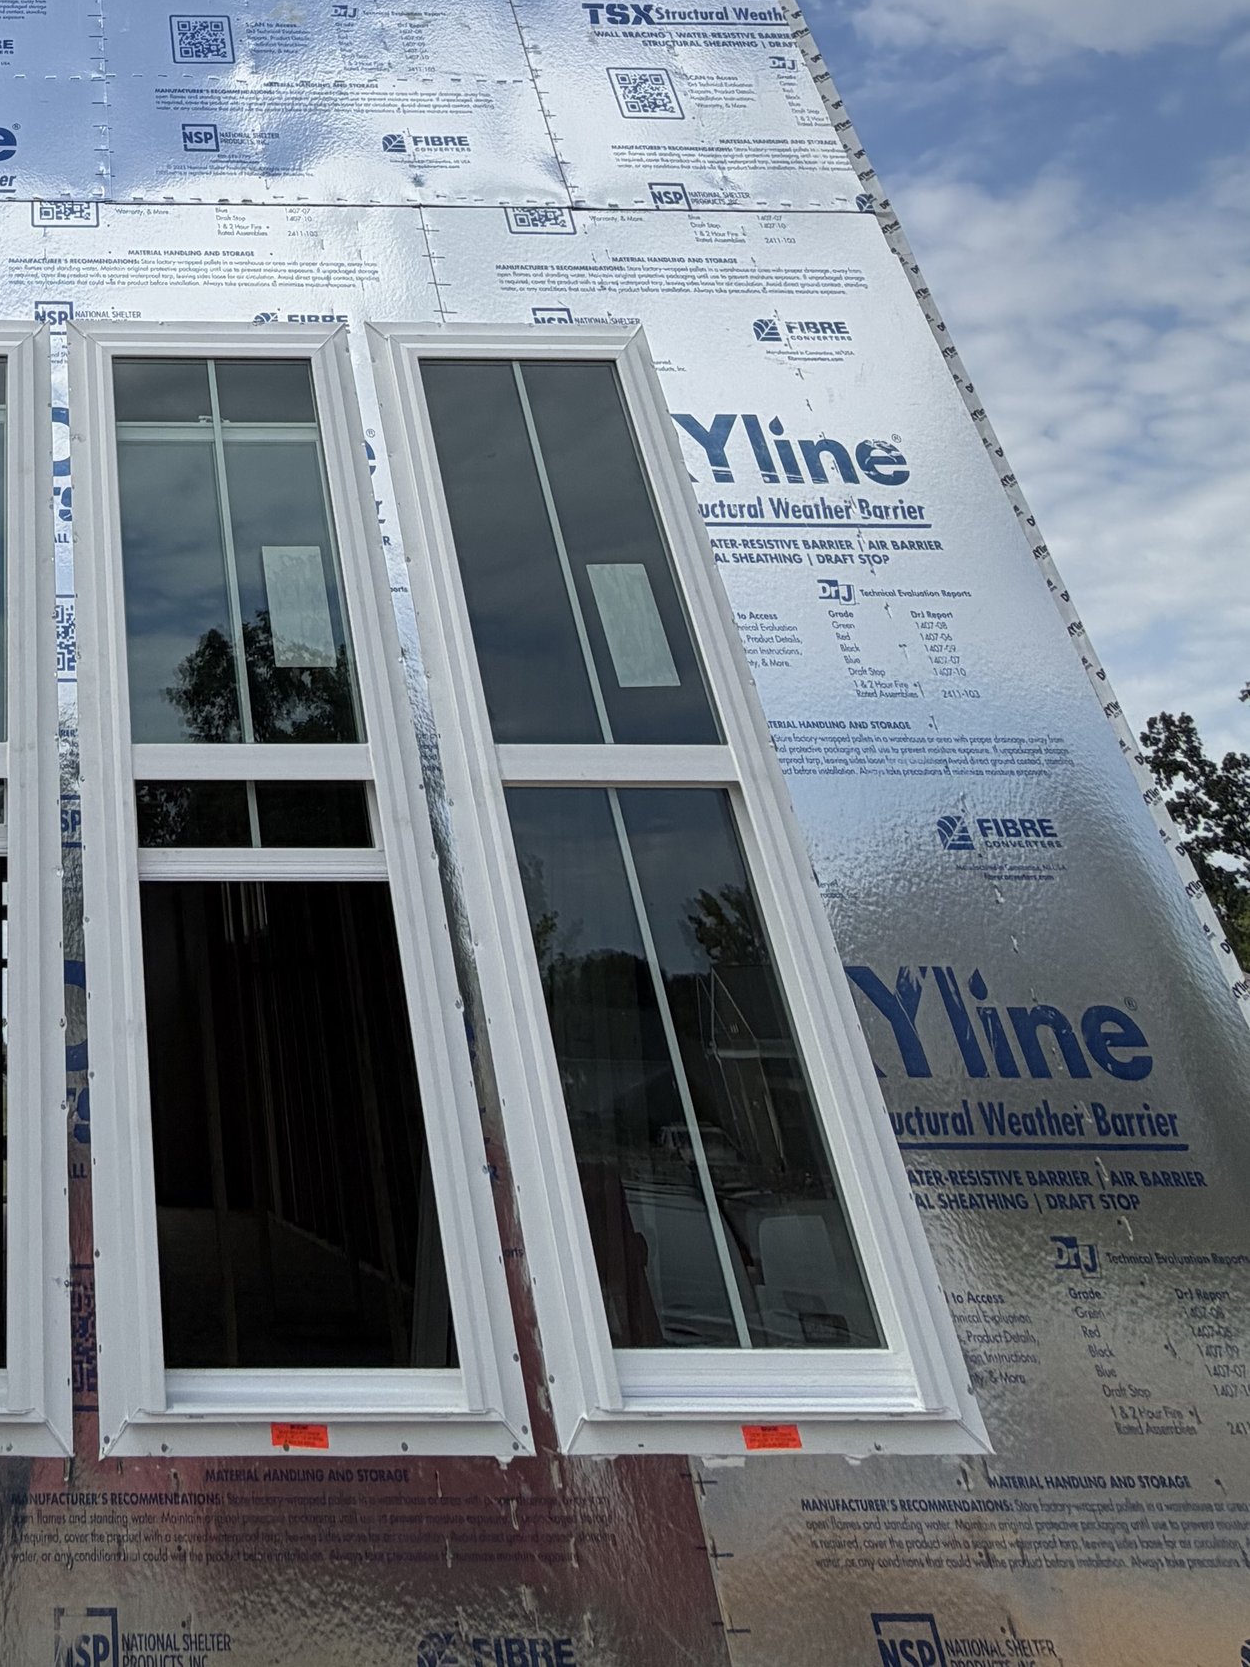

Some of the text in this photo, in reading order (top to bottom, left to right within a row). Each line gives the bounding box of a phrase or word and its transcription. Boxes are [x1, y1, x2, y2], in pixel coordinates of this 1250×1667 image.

[582, 3, 728, 25] TSX Structural
[413, 135, 470, 147] FIBRE
[786, 321, 850, 335] FIBRE
[698, 496, 925, 520] uctural Weather Barrier
[711, 539, 944, 551] ATER-RESISTIVE BARRIER AIR BARRIER
[860, 589, 972, 598] Technical Evaluation Reports
[749, 611, 778, 620] Access
[975, 818, 1058, 838] FIBRE
[985, 840, 1063, 849] CONVERTERS
[890, 1100, 1179, 1138] uctural Weather Barrier
[939, 1193, 1141, 1211] SHEATHING DRAFT STOP
[988, 1475, 1192, 1490] MATERIAL HANDLING AND STORAGE
[945, 1638, 1056, 1660] NATIONAL SHELTER
